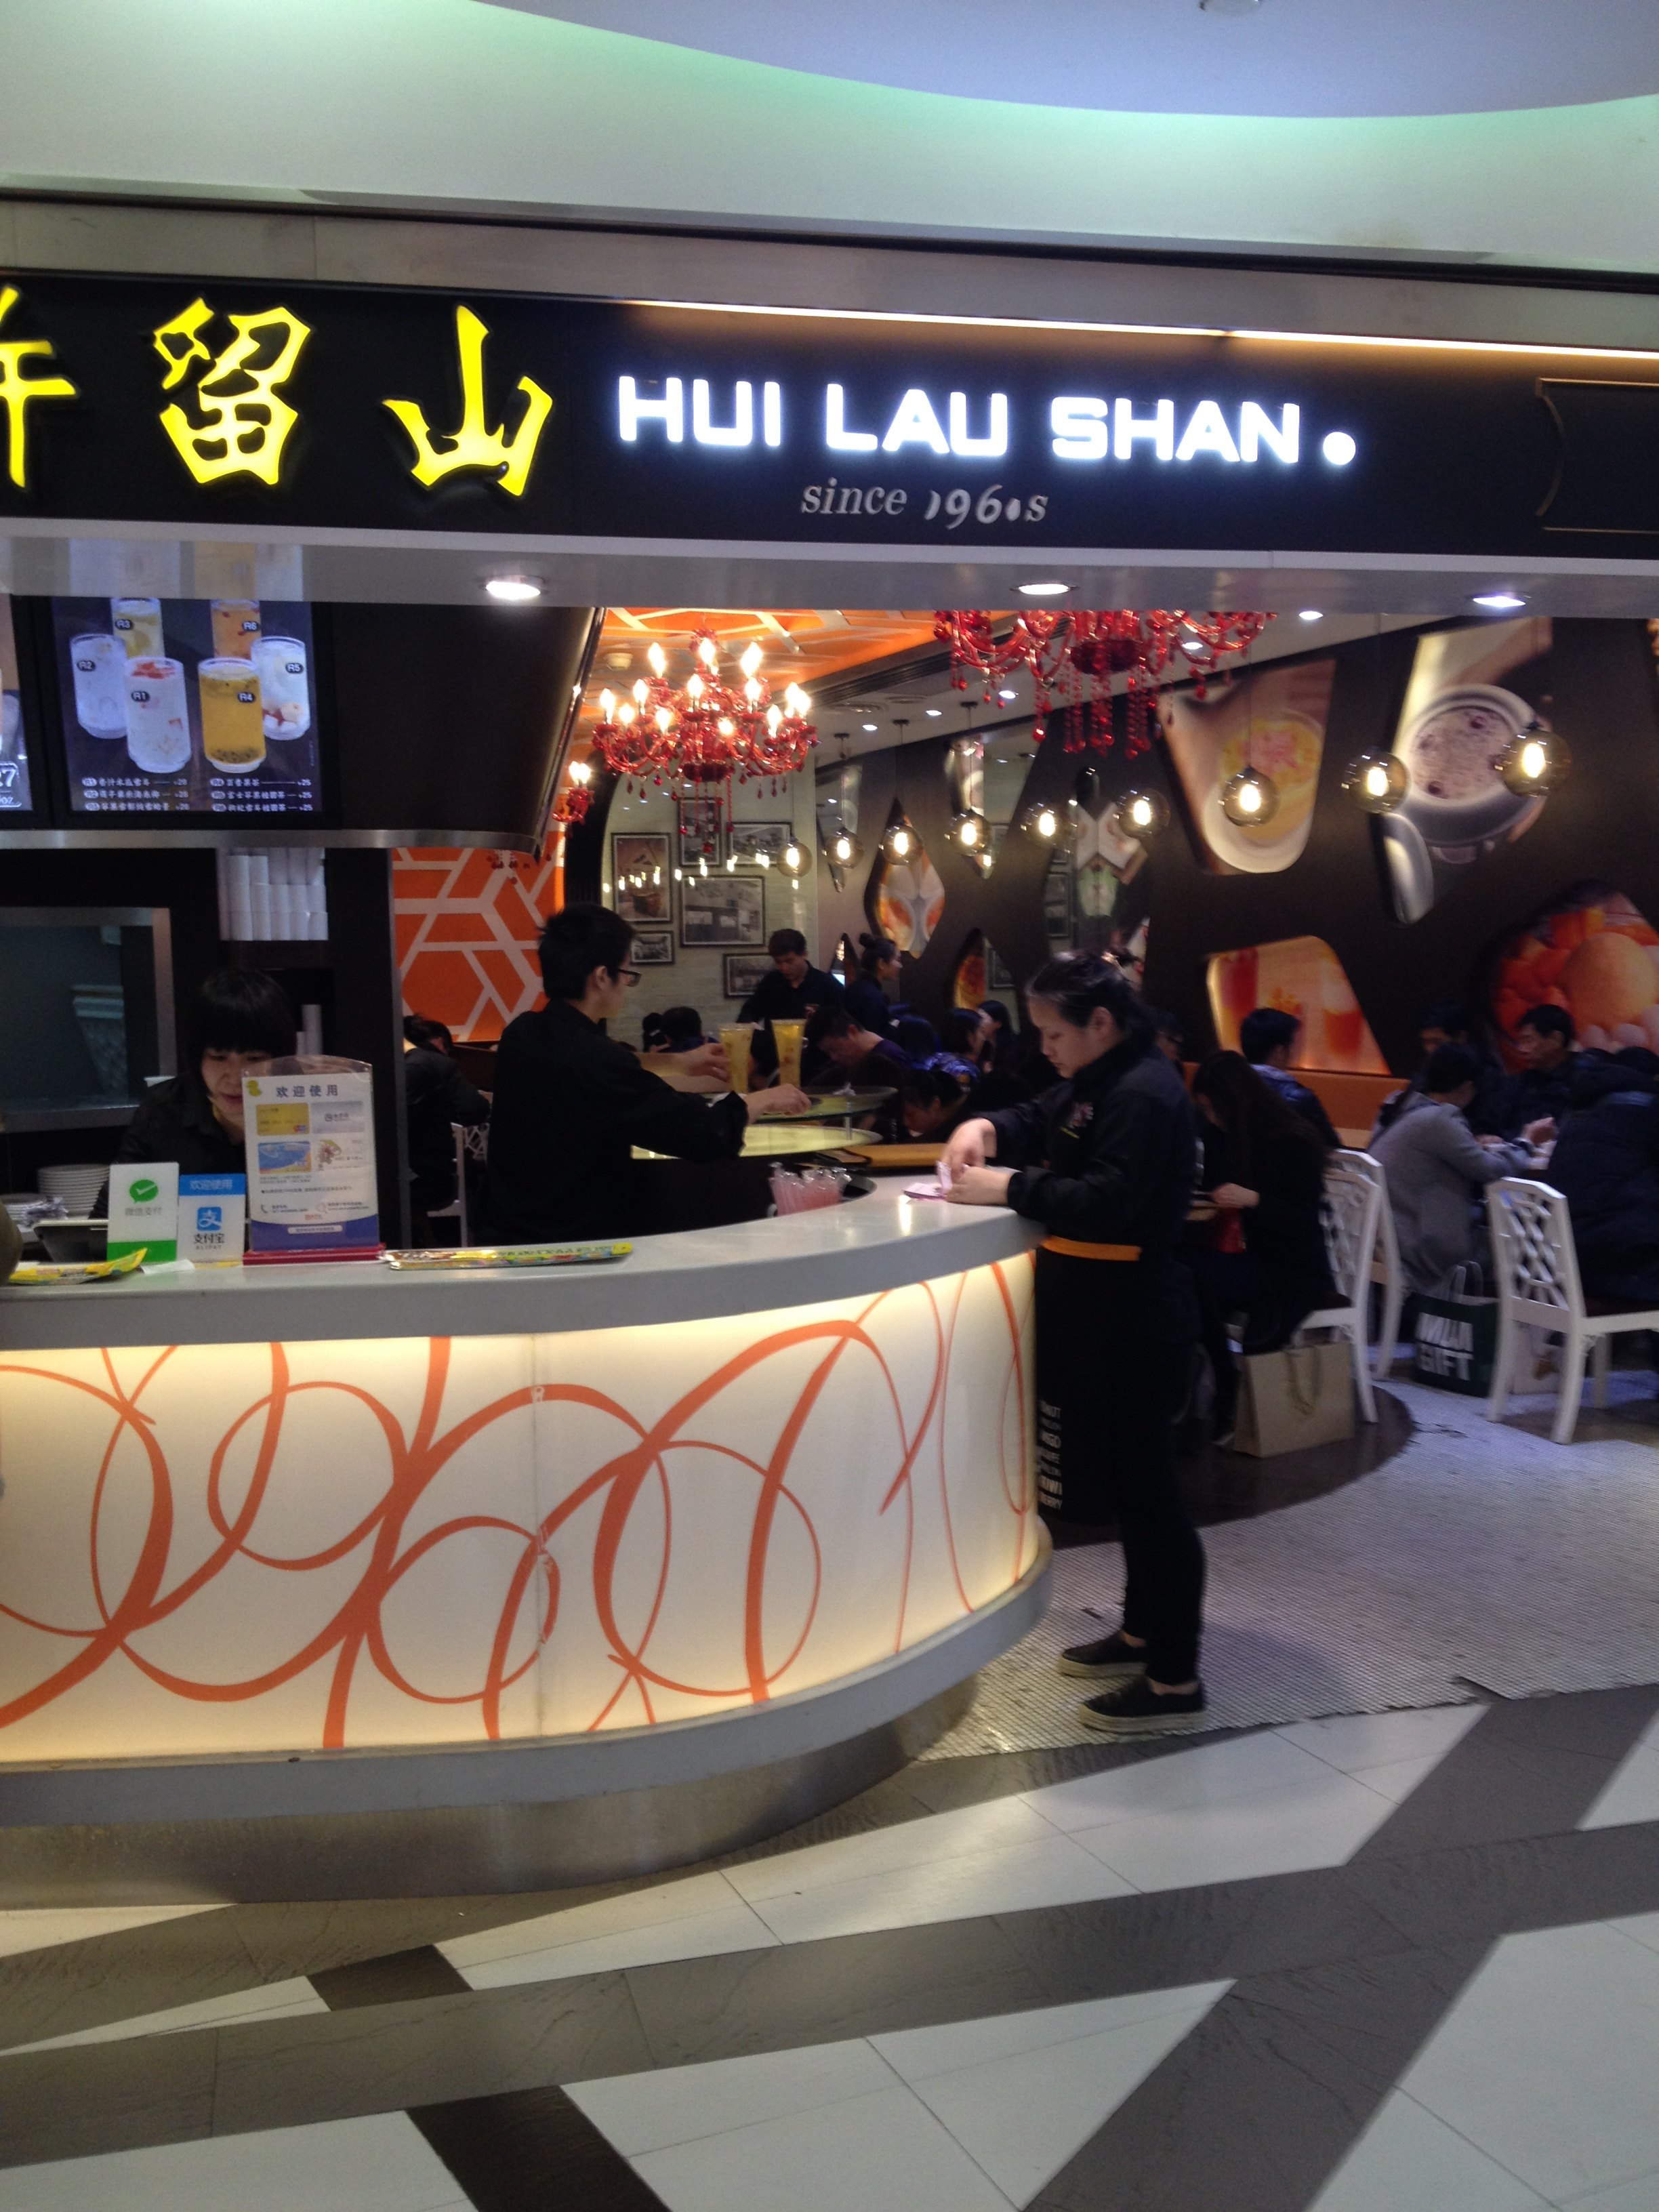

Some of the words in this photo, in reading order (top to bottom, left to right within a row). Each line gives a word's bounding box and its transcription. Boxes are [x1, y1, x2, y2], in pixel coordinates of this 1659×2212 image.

[618, 375, 781, 447] HUI
[825, 384, 1008, 457] LAU
[801, 476, 908, 515] since
[243, 621, 258, 631] R6
[78, 661, 93, 671] R2
[286, 663, 301, 672] R5
[134, 691, 147, 701] R1
[238, 692, 254, 702] R4
[0, 769, 16, 787] 7
[276, 1084, 338, 1097] 欢迎使用
[189, 1179, 232, 1190] 欢迎使用
[125, 1207, 162, 1216] 微信支付
[194, 1233, 225, 1244] 支付宝
